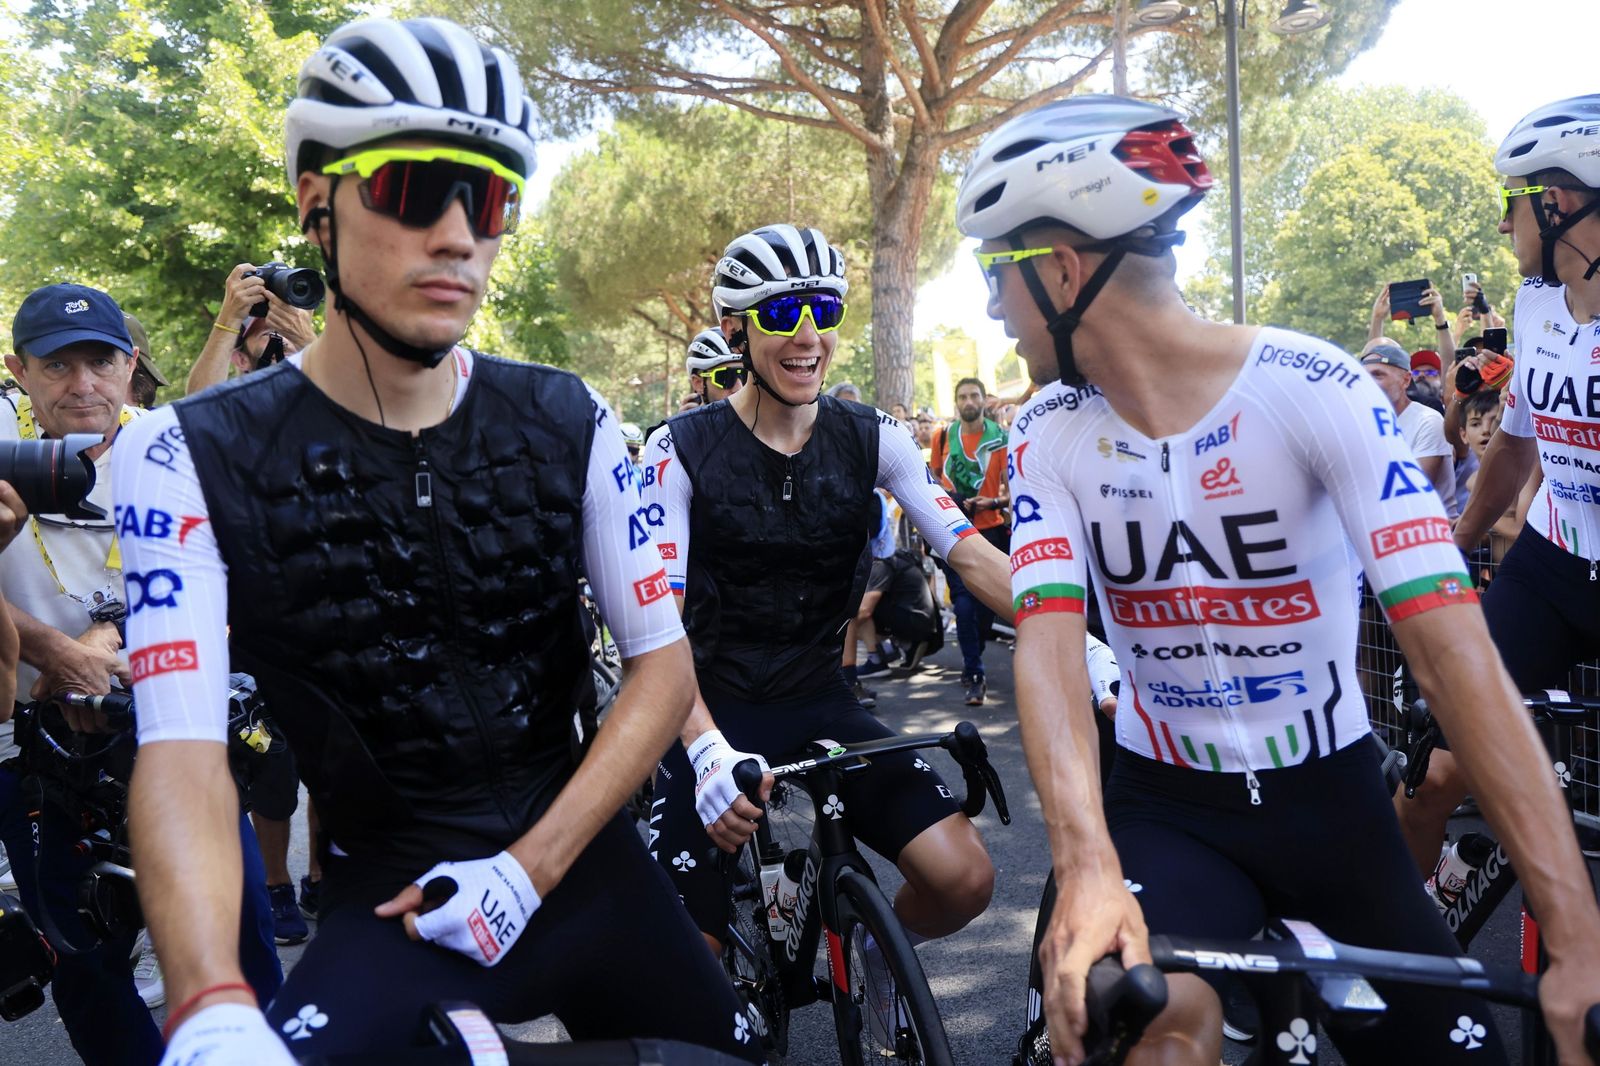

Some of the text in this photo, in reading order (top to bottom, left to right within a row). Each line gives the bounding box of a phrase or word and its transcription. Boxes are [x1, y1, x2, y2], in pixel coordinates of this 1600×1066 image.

[1036, 139, 1103, 173] MET
[720, 259, 752, 278] MET
[790, 280, 821, 289] MET
[1255, 343, 1363, 389] presight
[1194, 424, 1232, 456] FAB
[1532, 416, 1600, 447] Emirat
[1111, 487, 1153, 499] PISSEI
[1091, 509, 1297, 585] UAE
[1375, 518, 1453, 554] Emira
[1109, 591, 1313, 624] Emirates
[1152, 694, 1244, 708] ADNOC
[481, 888, 516, 946] UAE
[786, 856, 817, 962] COLNAGO
